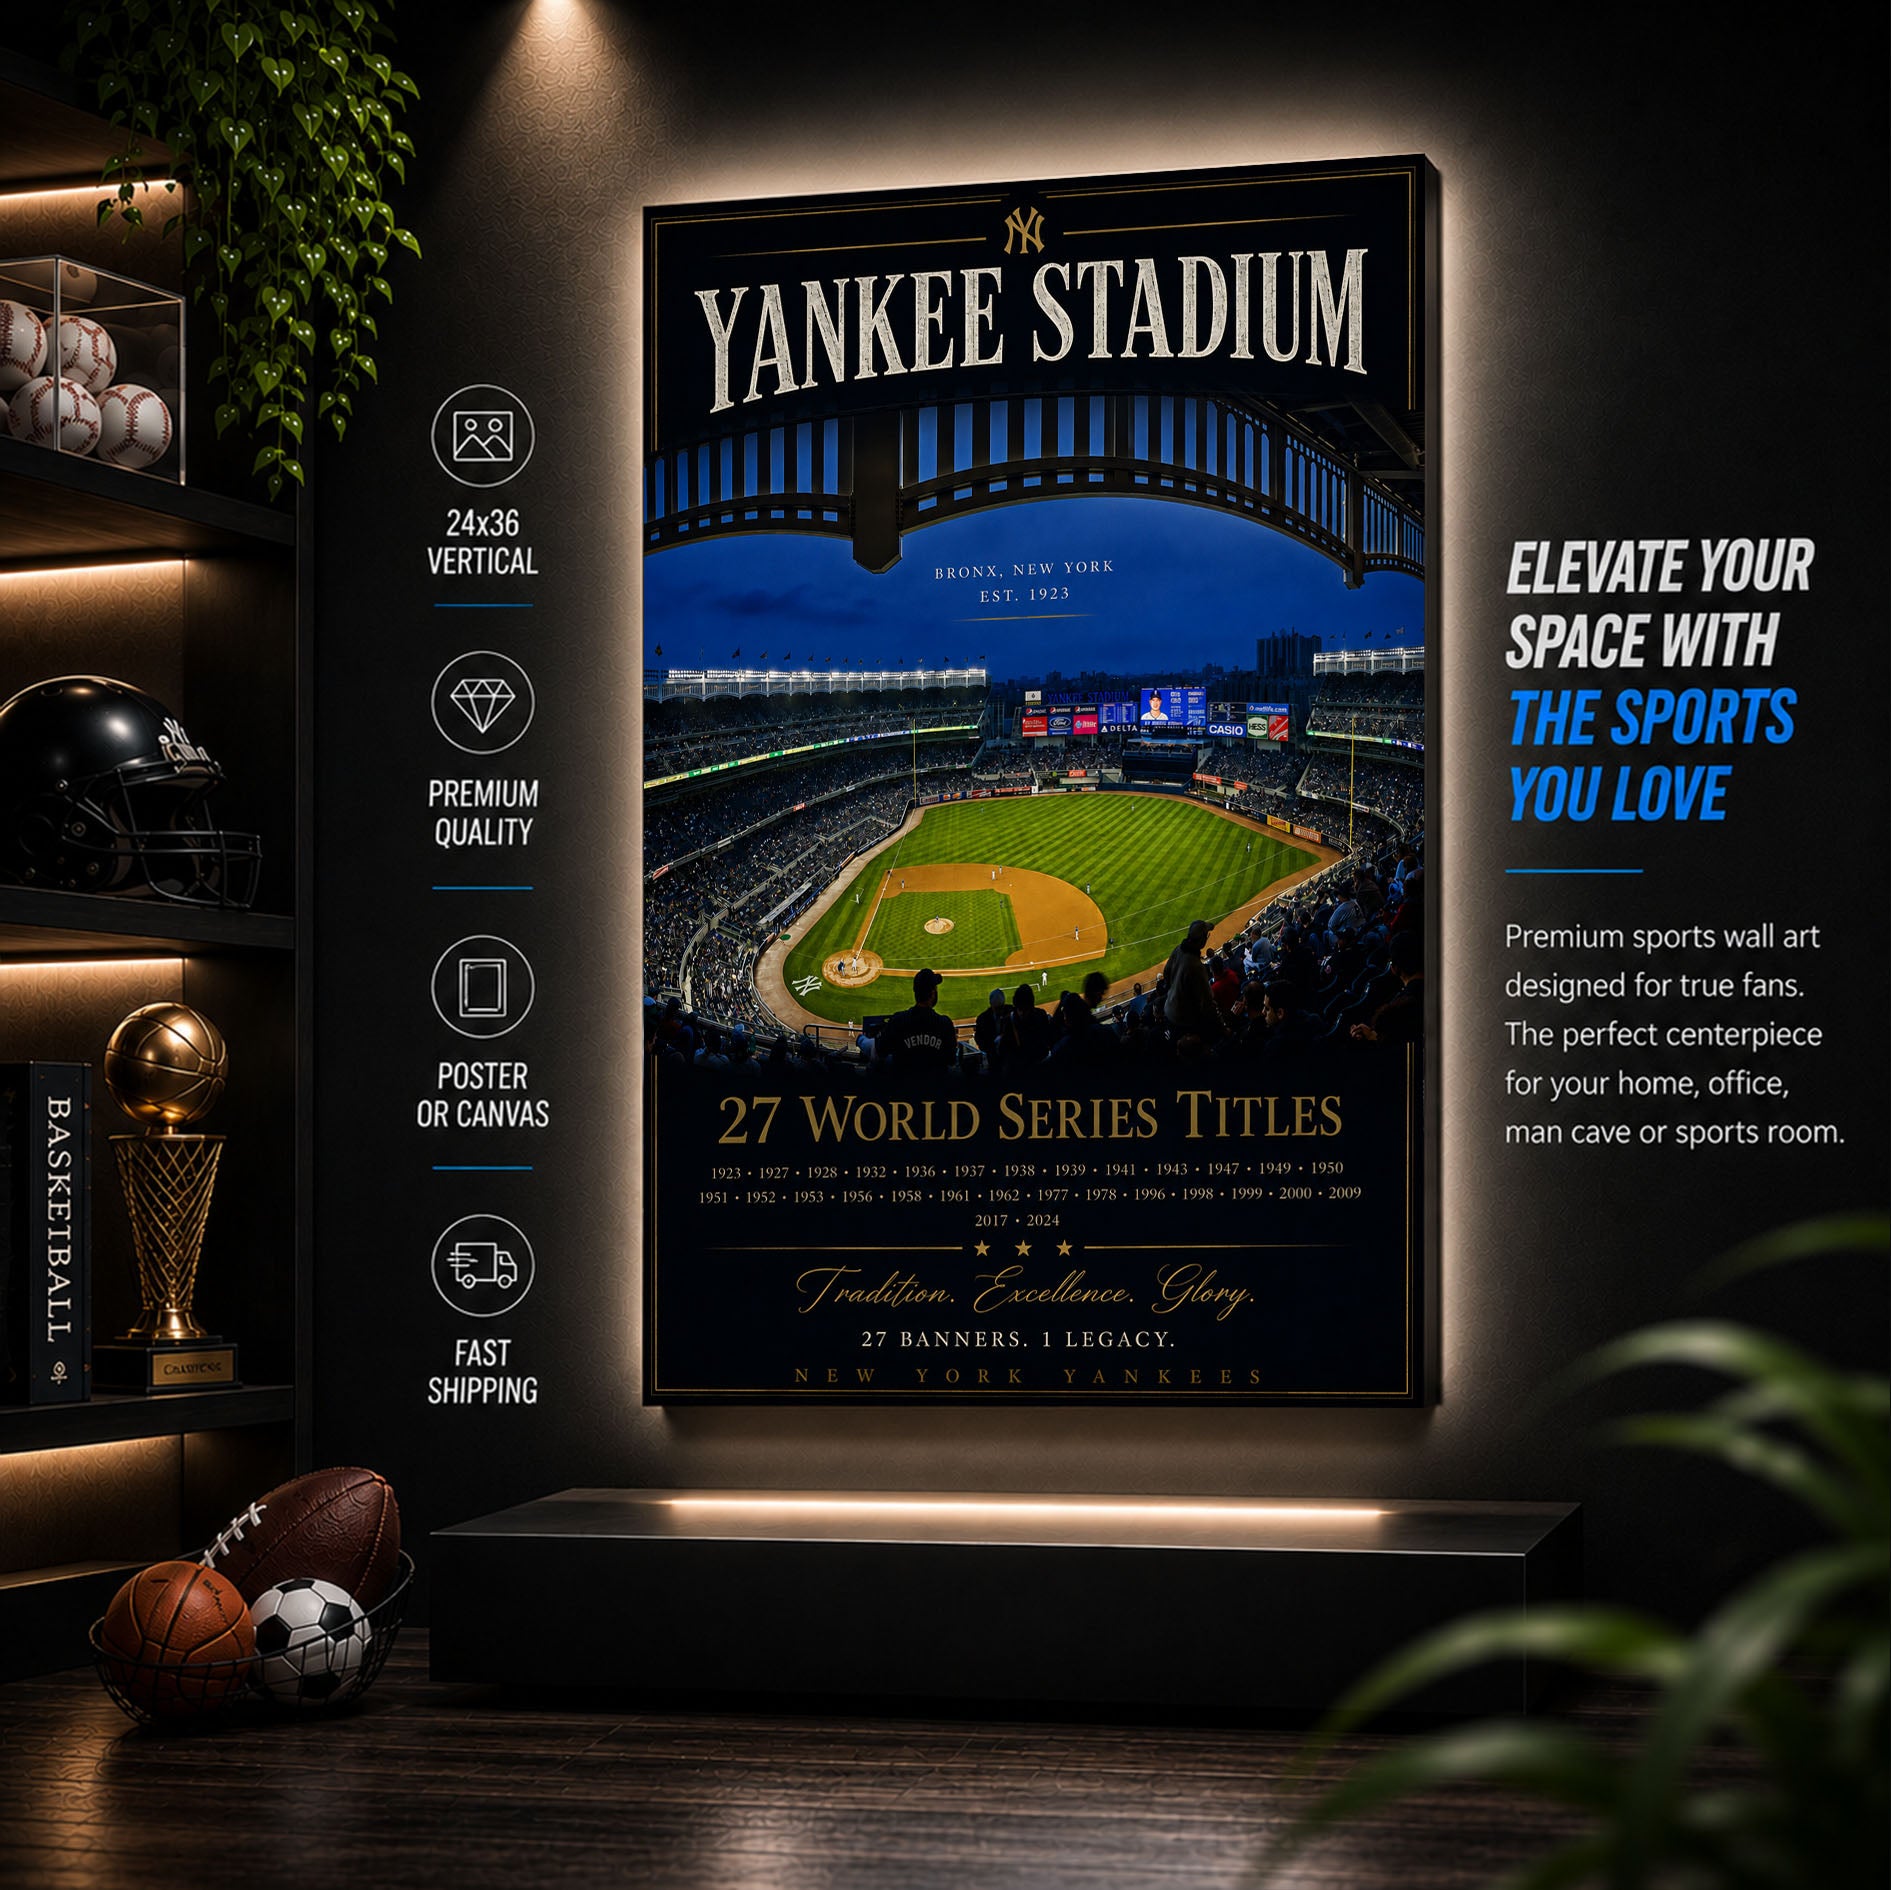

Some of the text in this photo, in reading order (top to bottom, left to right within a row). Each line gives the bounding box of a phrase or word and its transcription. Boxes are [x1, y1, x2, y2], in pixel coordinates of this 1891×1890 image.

[1003, 206, 1046, 255] NY
[694, 248, 1369, 414] YANKEE STADIUM
[934, 560, 1116, 582] BRONX, NEW YORK
[980, 586, 1071, 603] EST. 1923
[1109, 724, 1138, 733] DELTA
[1208, 723, 1245, 737] CASIO
[1248, 723, 1267, 732] HESS
[904, 1034, 943, 1050] VENDOR
[718, 1095, 782, 1144] 27
[711, 1161, 1344, 1180] 1923 1927 1928 1932 1936 1937 1938 1939 1941 1943 1947 1949 1950
[699, 1186, 1362, 1204] 1951 1952 1953 1956 1958 1961 1962 1977 1978 1996 1998 1999 2000 2009
[975, 1214, 1060, 1227] 2017 2024
[796, 1263, 1255, 1321] Tradition. Excellence. Glory.
[861, 1331, 1175, 1348] 27 BANNERS. 1 LEGACY.
[794, 1368, 1261, 1384] NEW YORK YANKEES
